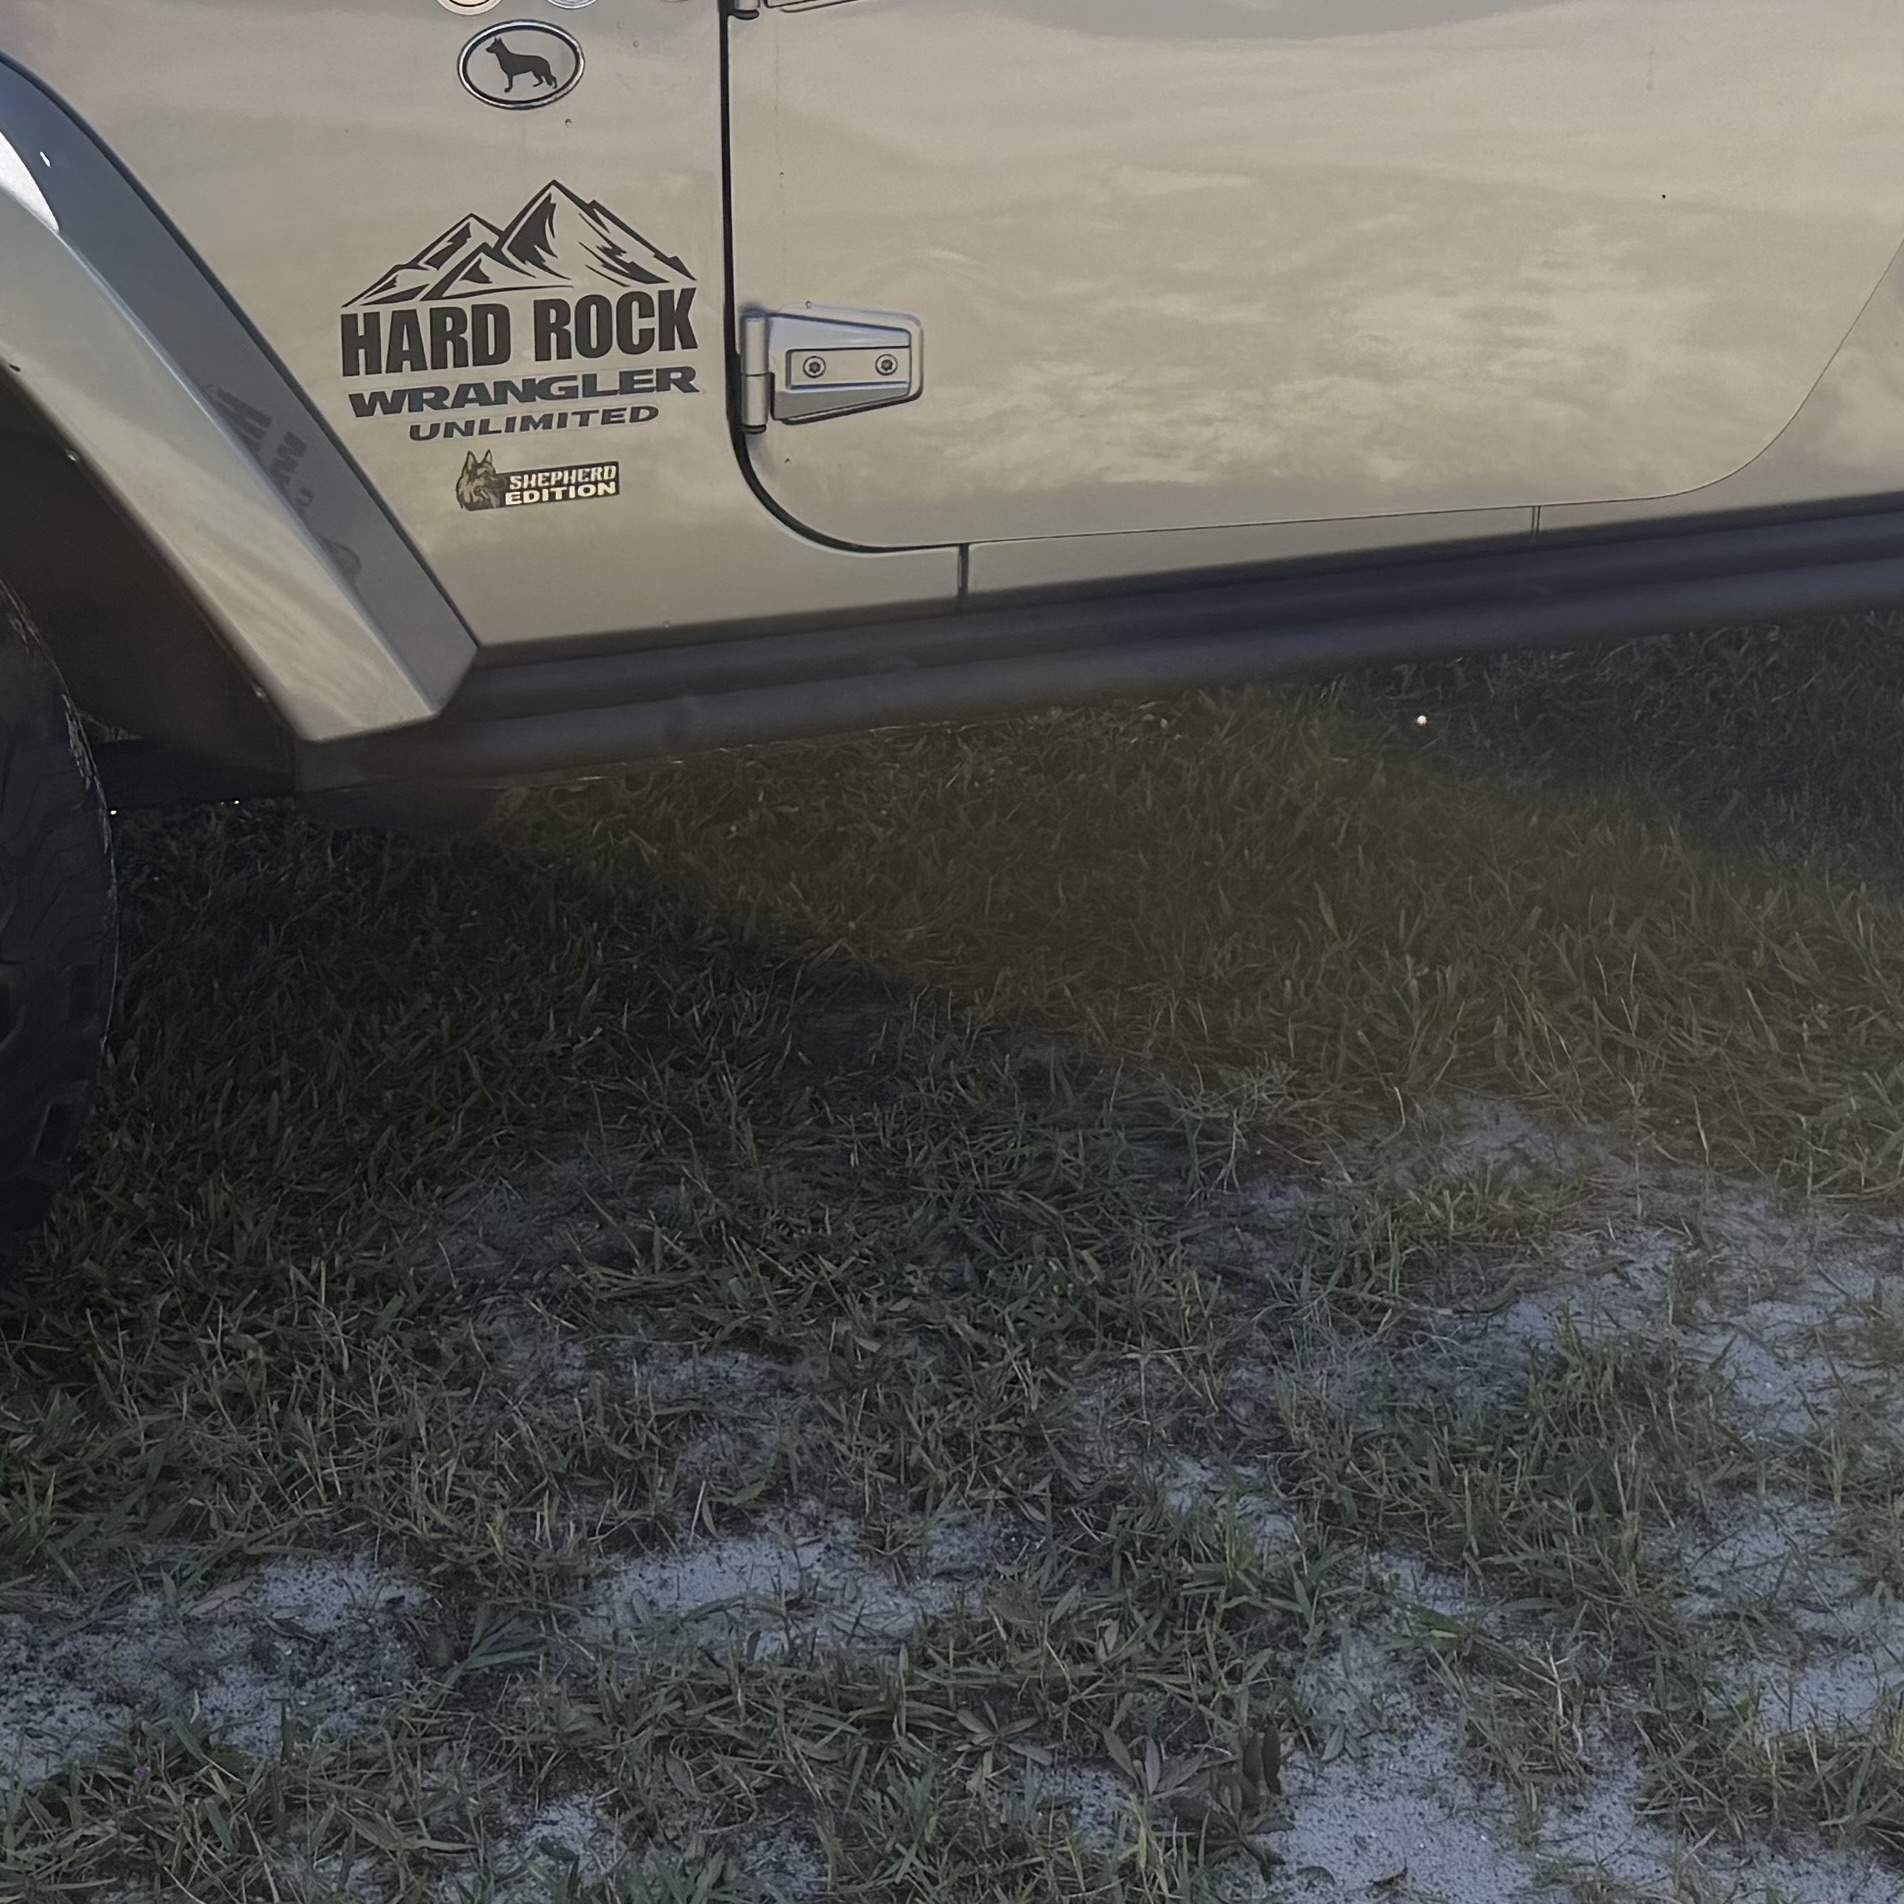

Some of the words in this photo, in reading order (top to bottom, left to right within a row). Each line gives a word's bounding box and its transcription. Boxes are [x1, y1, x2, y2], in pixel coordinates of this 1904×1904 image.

[340, 303, 511, 377] HARD
[533, 287, 698, 362] ROCK
[348, 366, 700, 418] WRANGLER
[409, 406, 660, 441] UNLIMITED
[505, 482, 616, 506] EDITION
[509, 465, 617, 490] SHEPHERD
